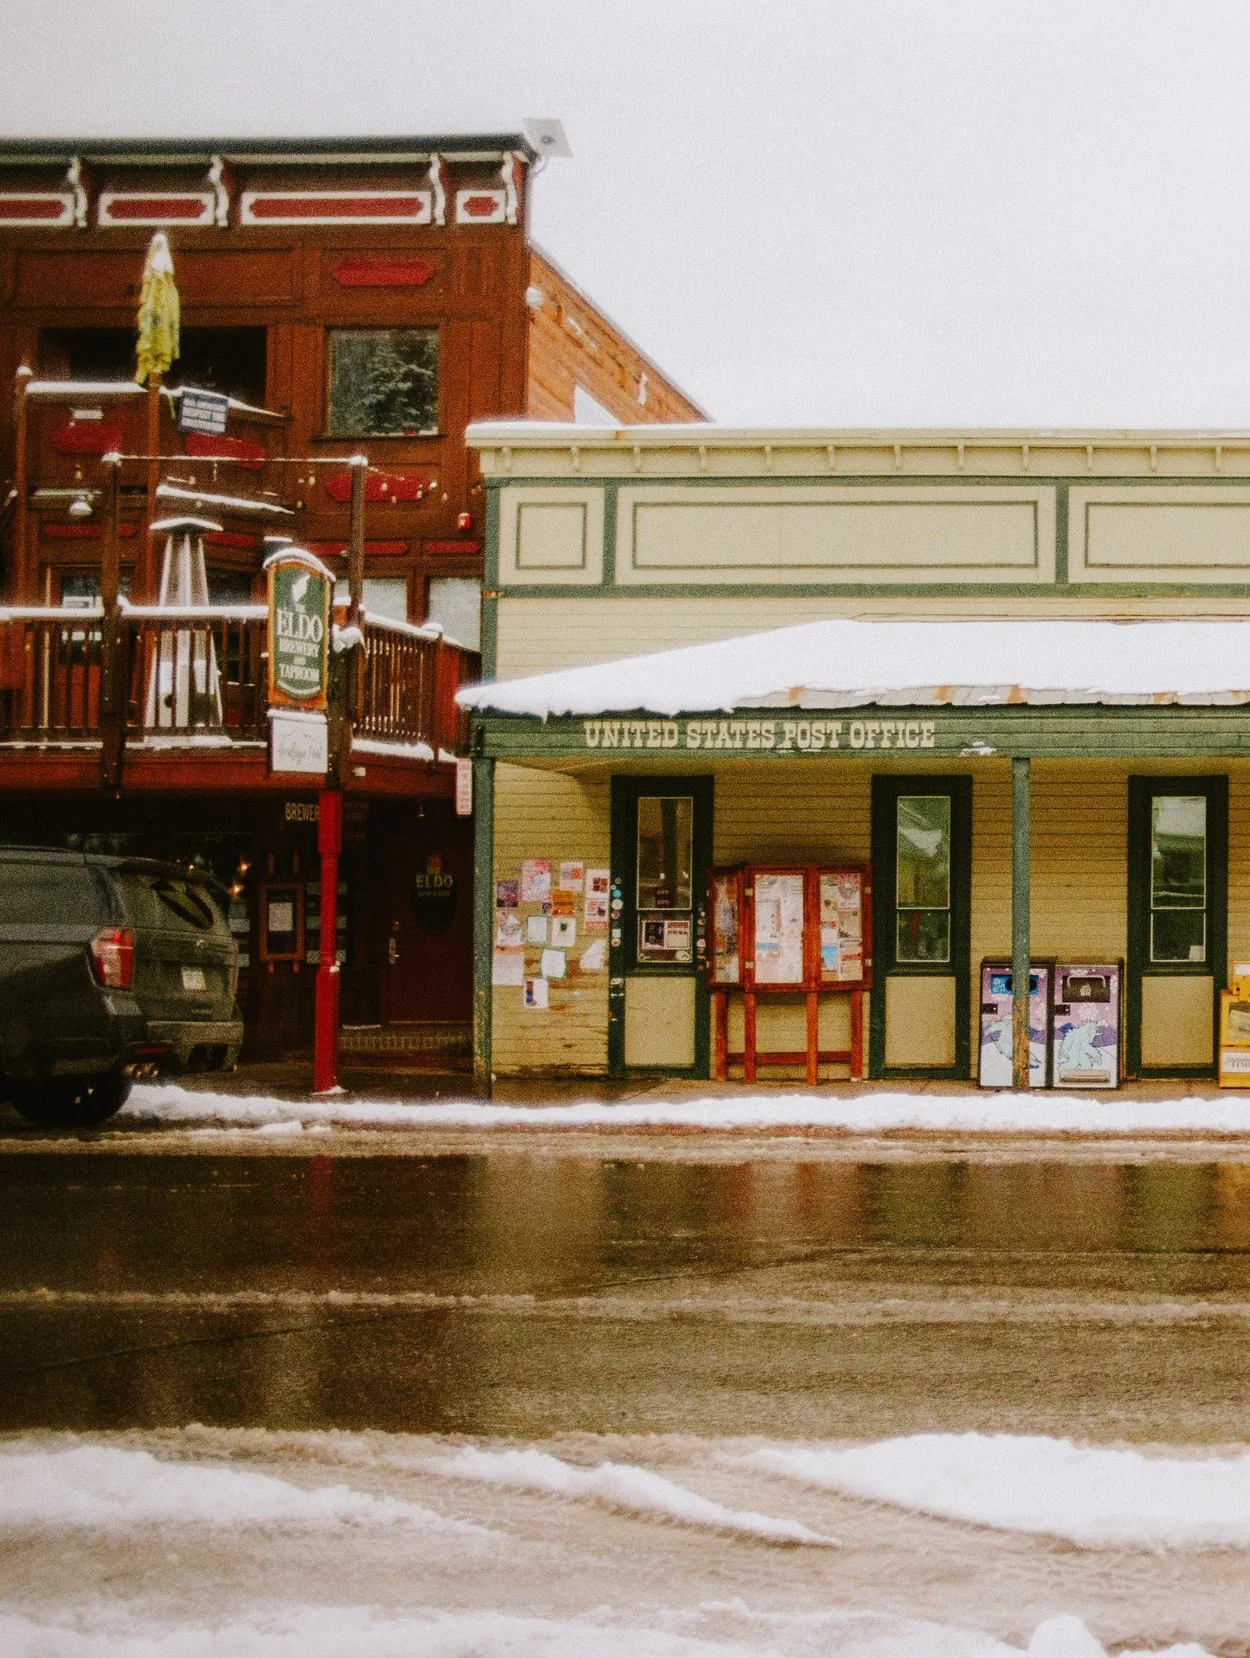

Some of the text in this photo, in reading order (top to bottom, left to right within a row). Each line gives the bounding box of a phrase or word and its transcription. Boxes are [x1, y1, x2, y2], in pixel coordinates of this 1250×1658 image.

[276, 607, 323, 642] ELDO
[279, 638, 320, 657] BREWERY
[583, 721, 935, 749] UNITED STATES POST OFFICE
[415, 873, 453, 888] ELDO
